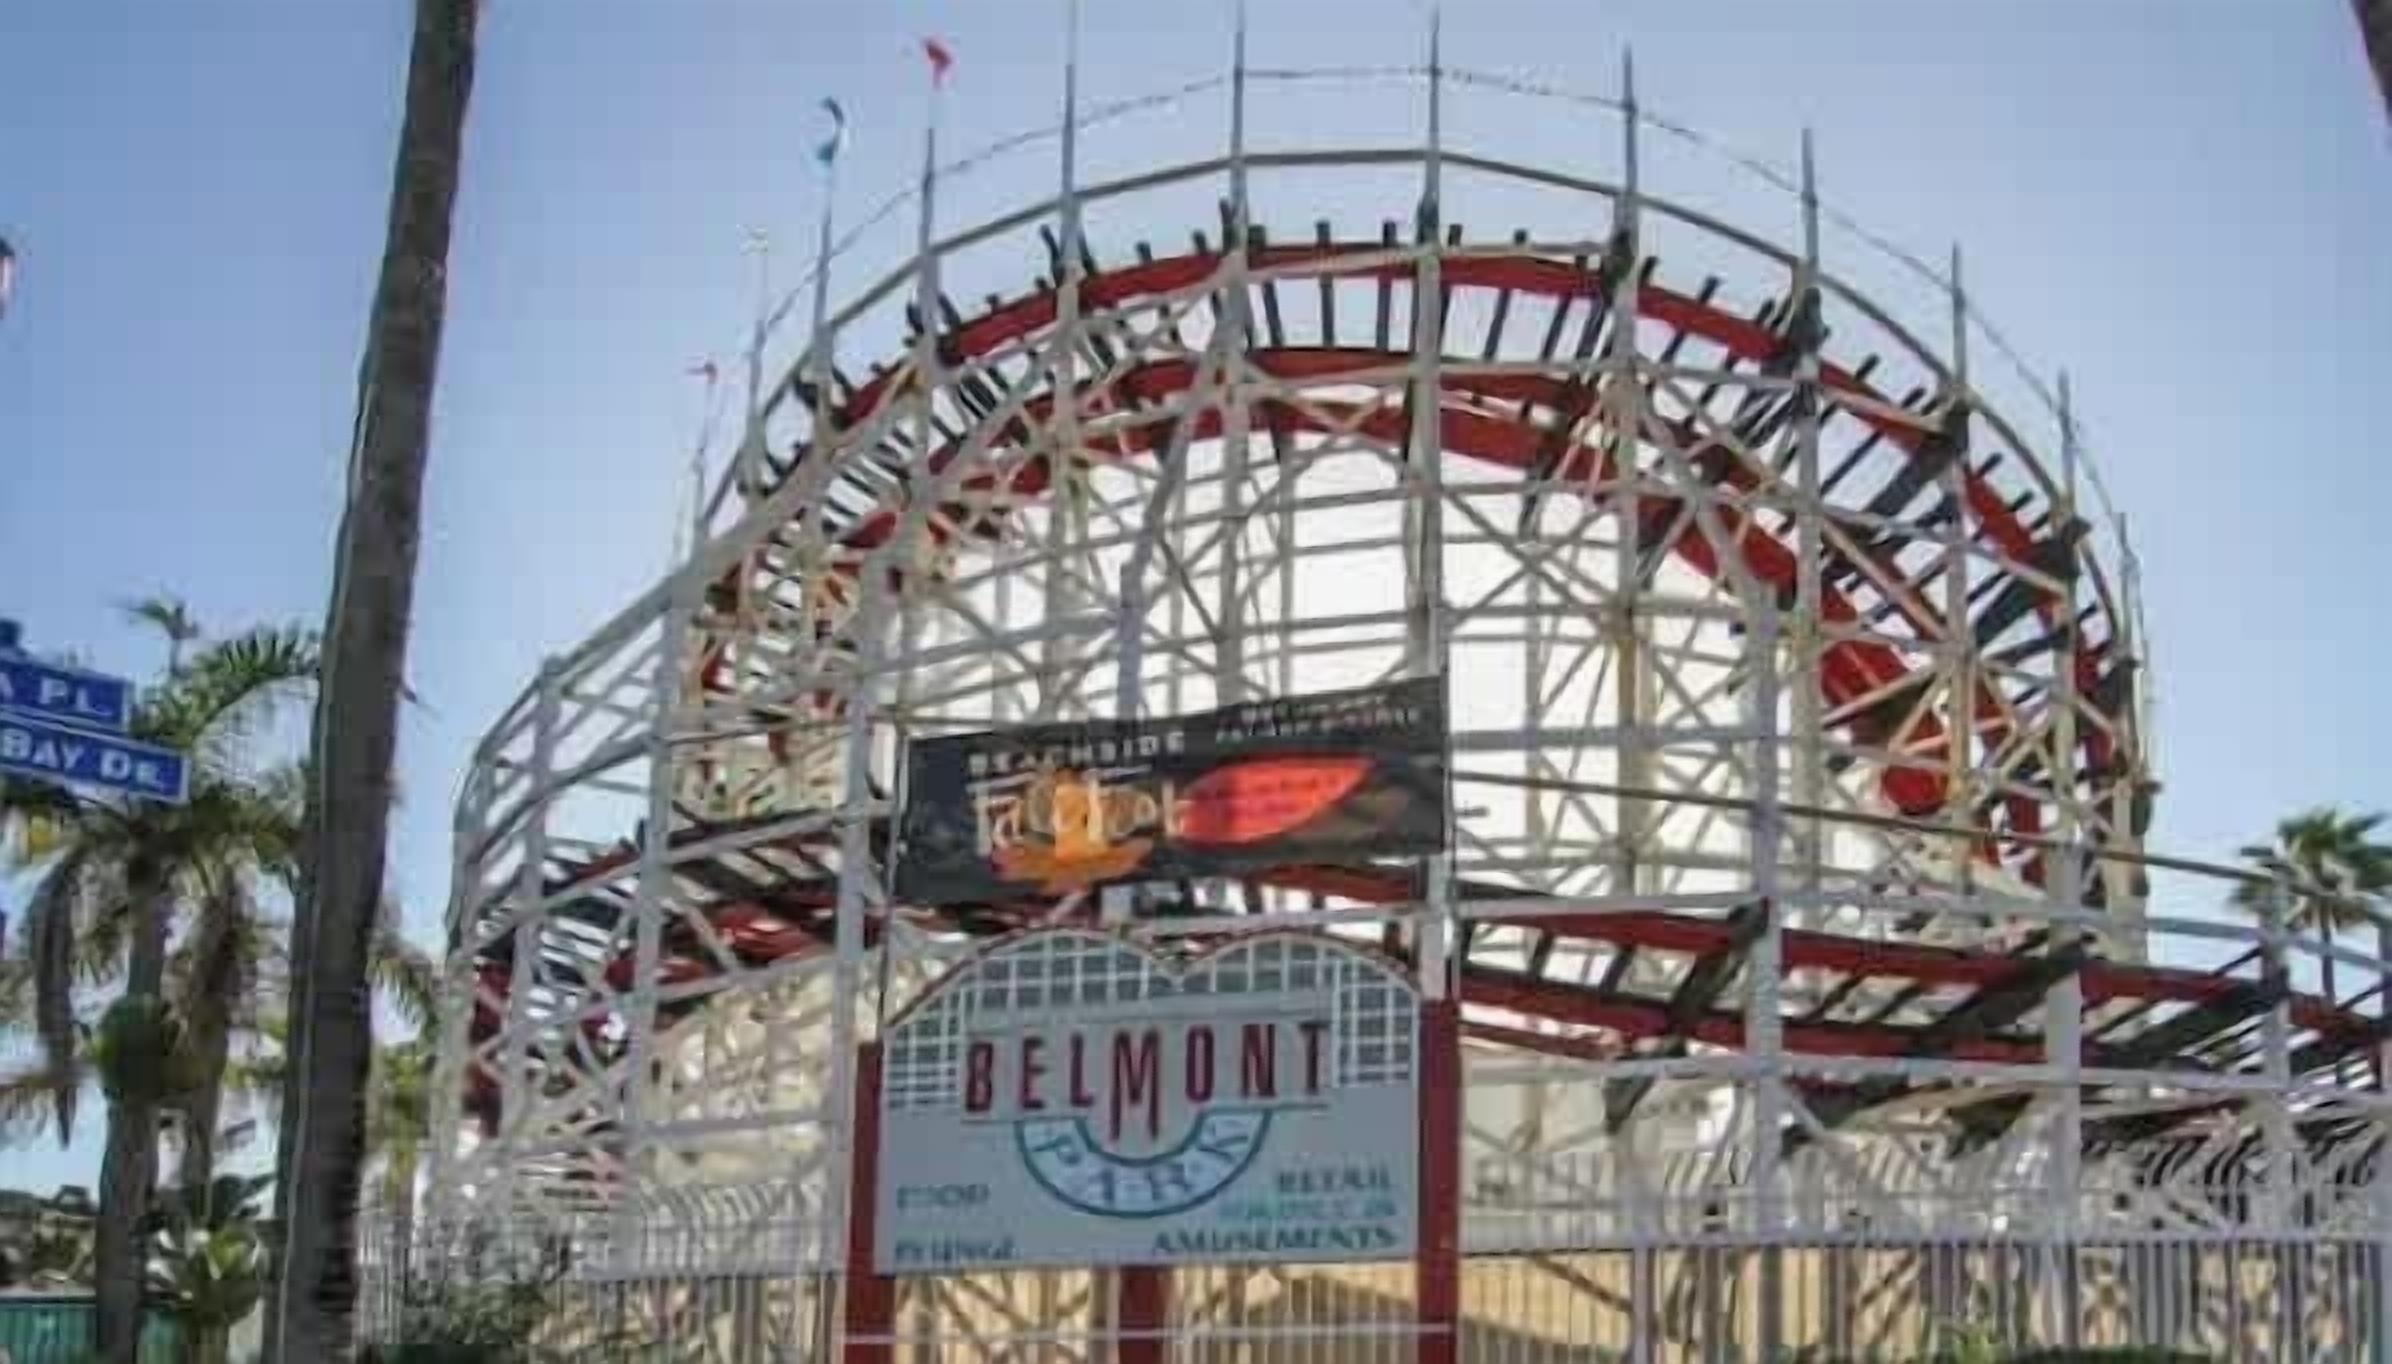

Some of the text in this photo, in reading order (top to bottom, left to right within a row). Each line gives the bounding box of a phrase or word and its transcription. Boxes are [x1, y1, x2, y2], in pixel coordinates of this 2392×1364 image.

[1, 727, 85, 770] BAY
[965, 1022, 1330, 1142] BELMONT
[1031, 1116, 1252, 1204] PARK
[1277, 1164, 1393, 1194] RETAIL
[1152, 1223, 1400, 1253] AMUSEMENTS
